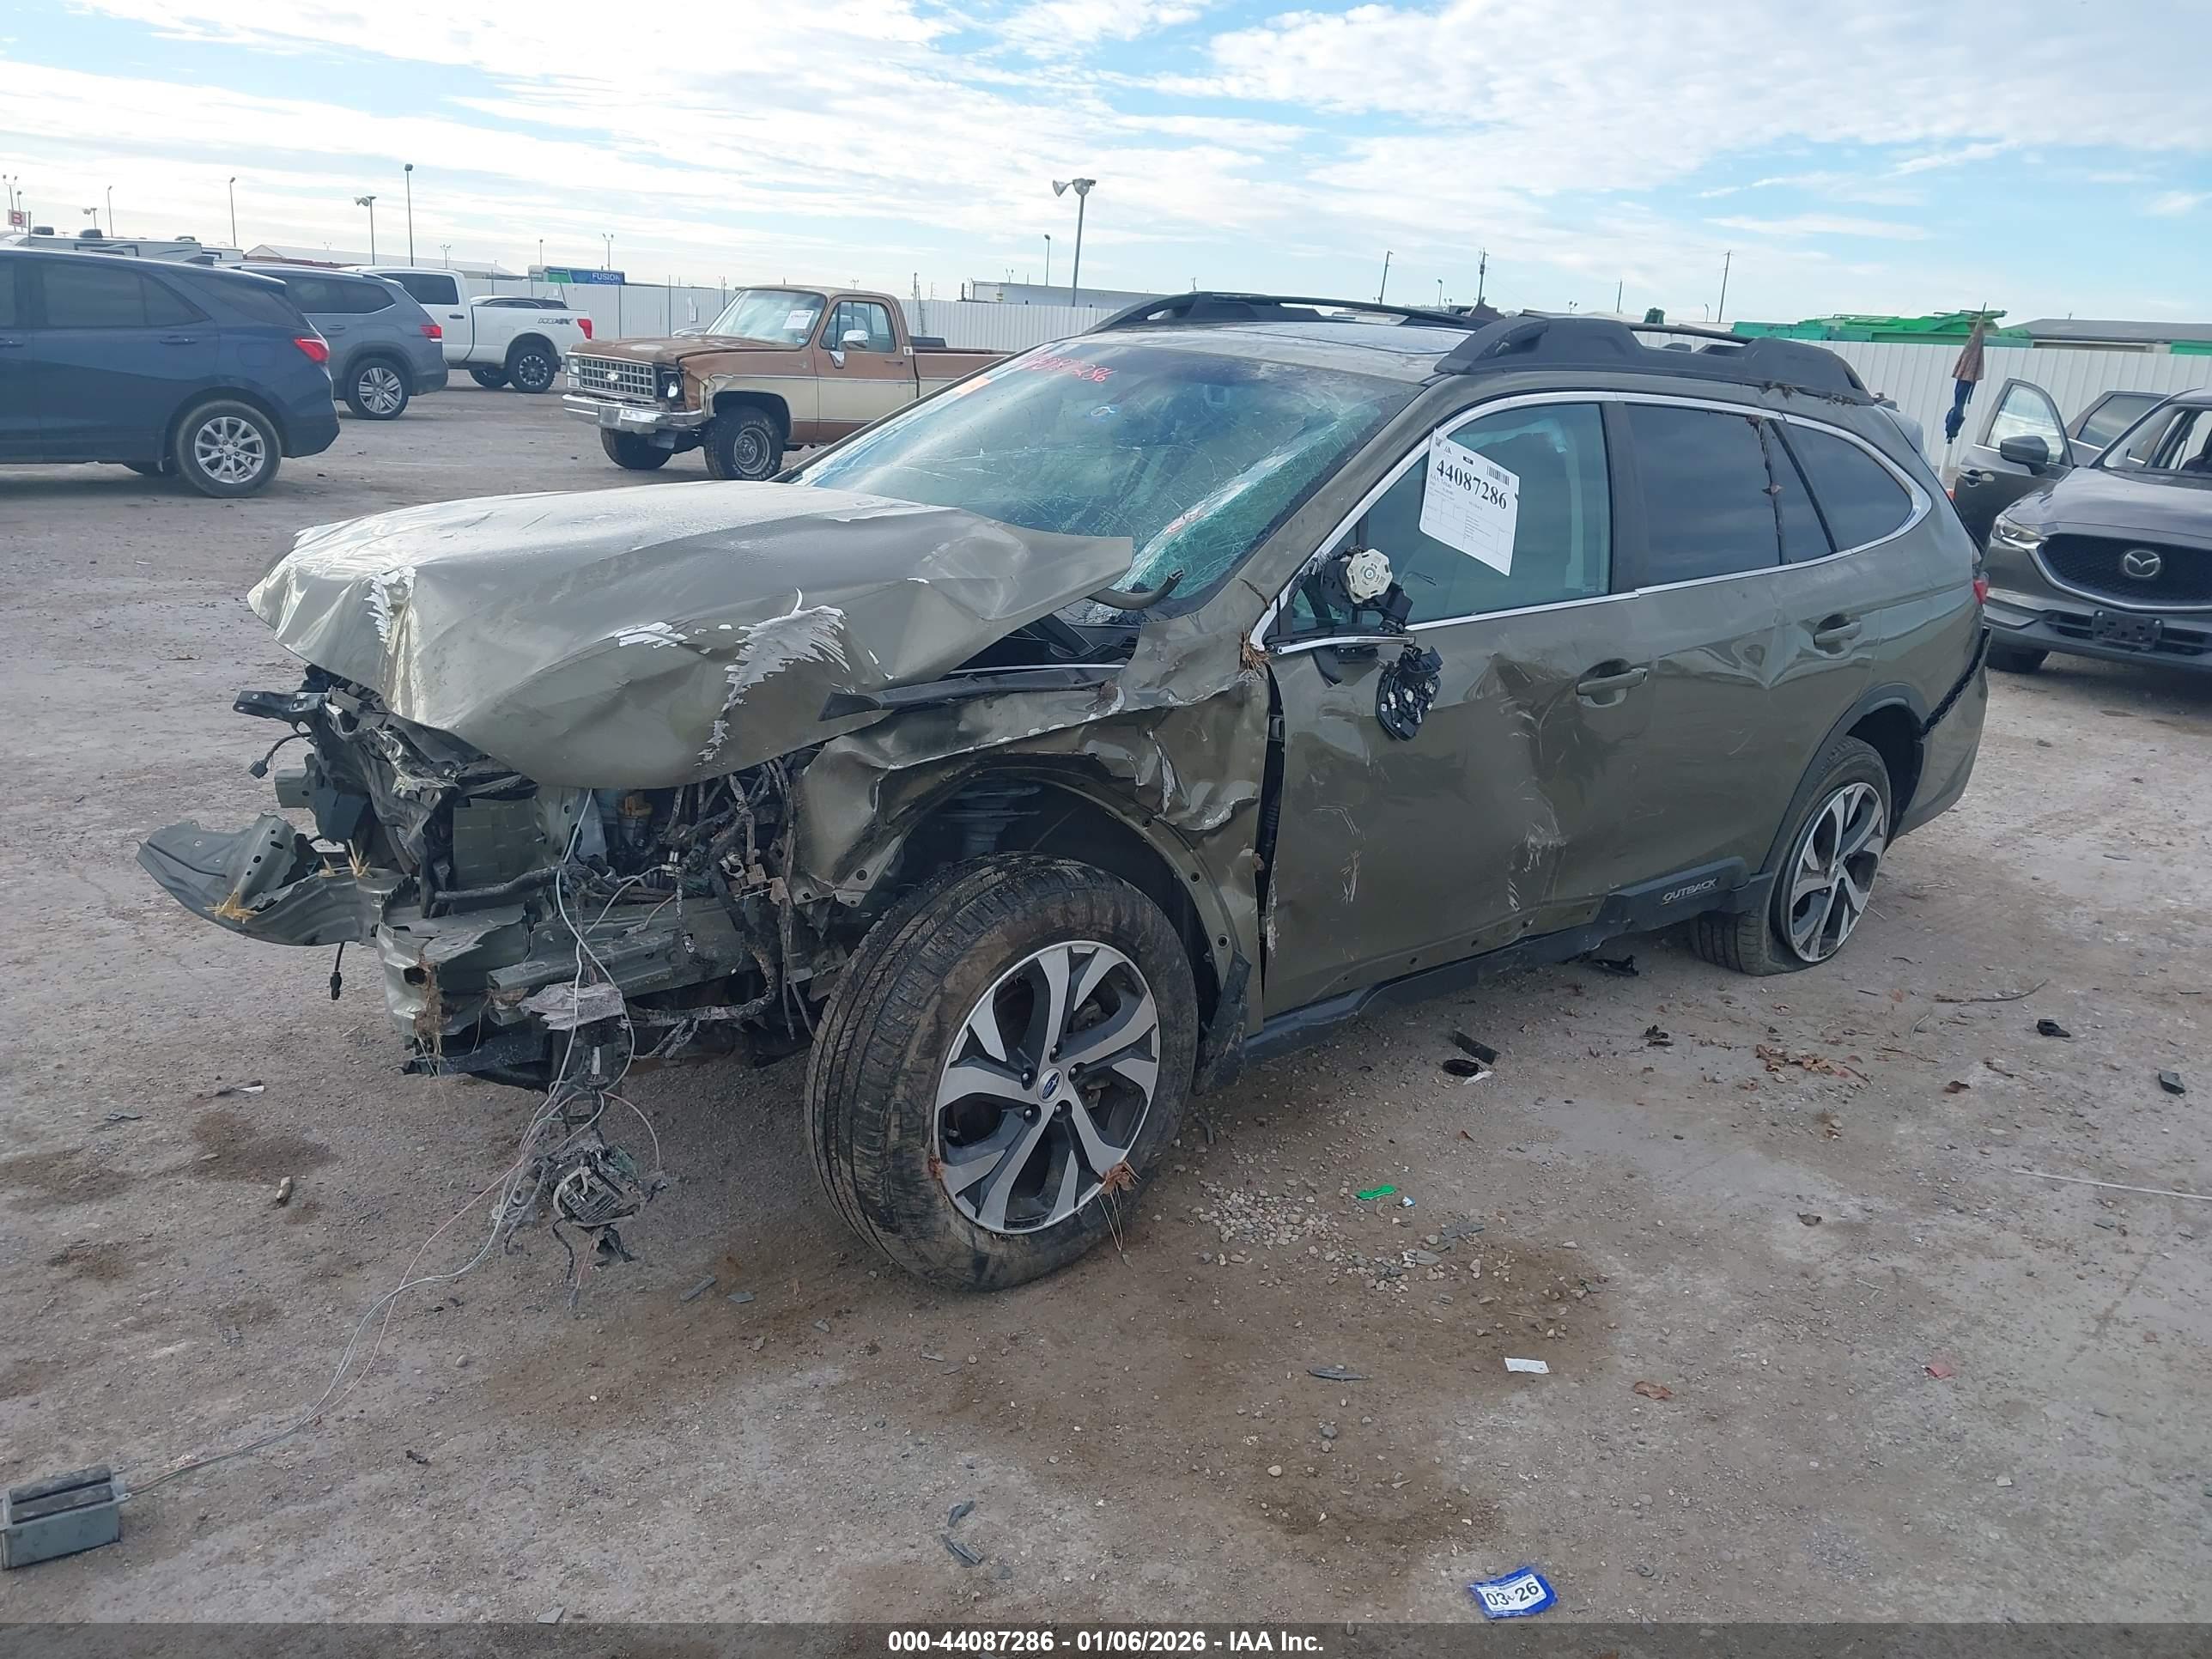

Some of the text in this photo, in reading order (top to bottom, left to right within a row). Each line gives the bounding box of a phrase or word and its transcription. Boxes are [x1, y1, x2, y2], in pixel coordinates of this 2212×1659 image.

[12, 212, 22, 224] B
[1437, 459, 1507, 509] 44087286
[1662, 878, 1717, 902] OUTBACK
[1486, 1592, 1510, 1607] 03
[1515, 1581, 1540, 1602] 26
